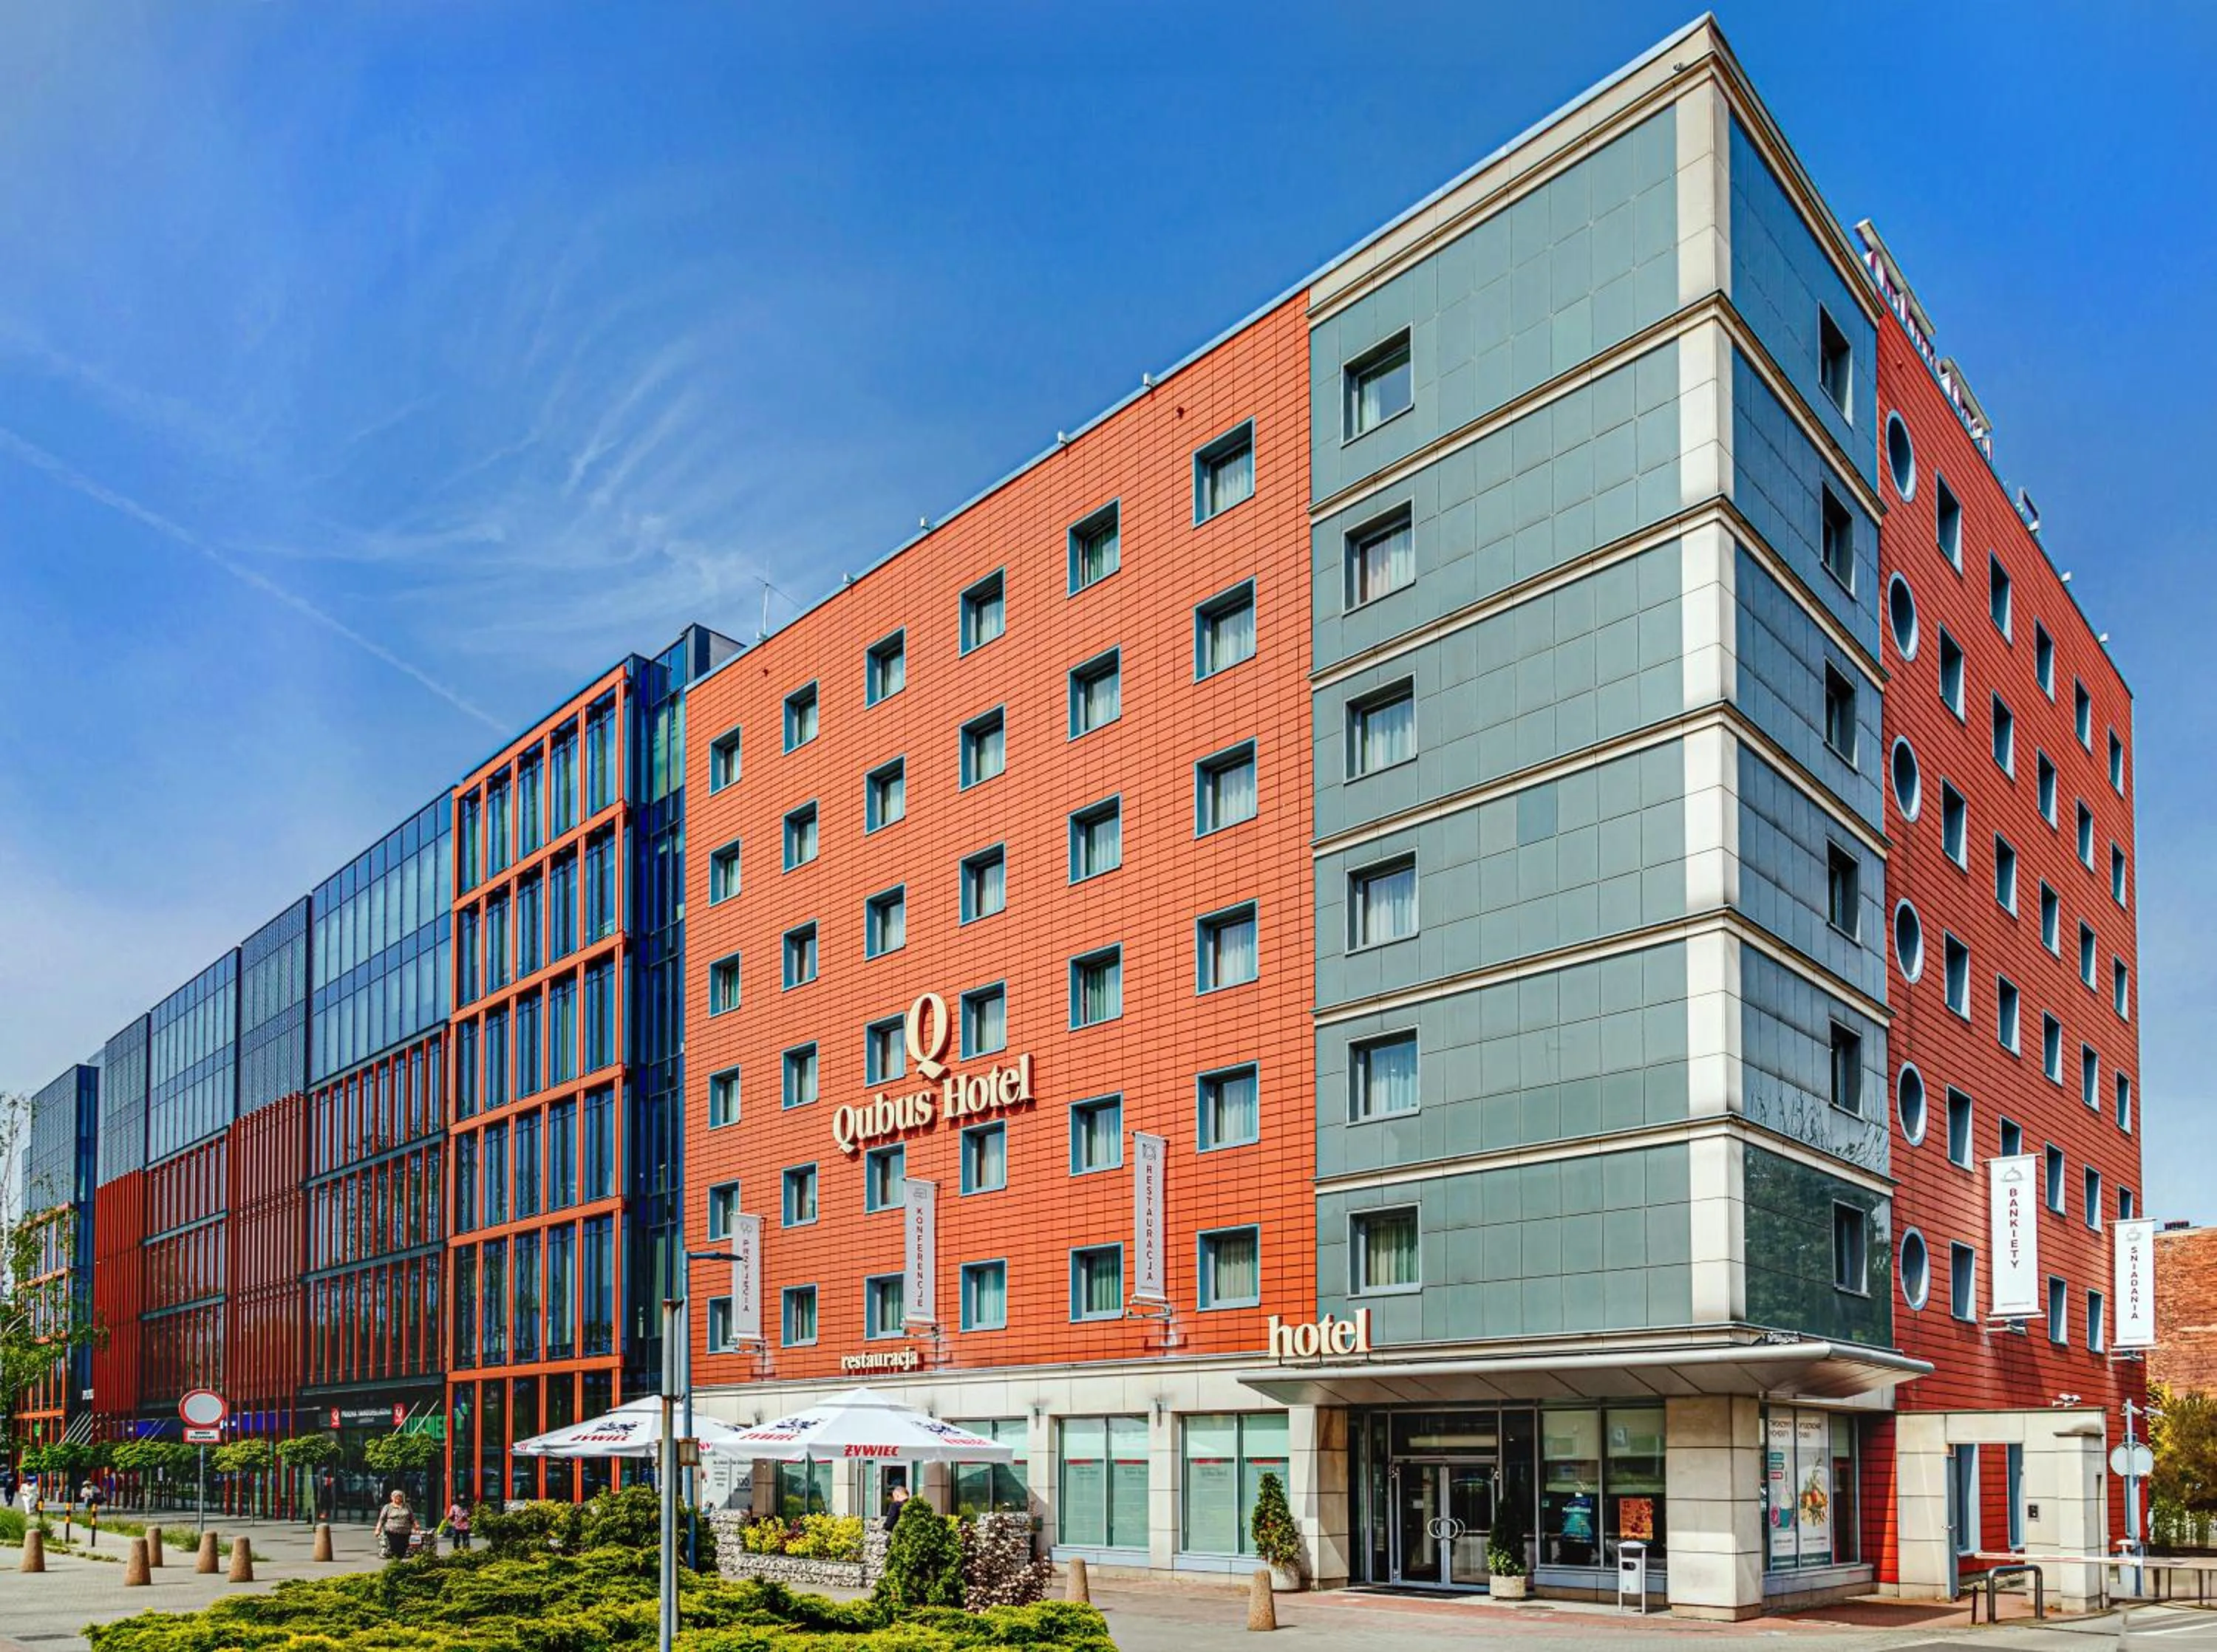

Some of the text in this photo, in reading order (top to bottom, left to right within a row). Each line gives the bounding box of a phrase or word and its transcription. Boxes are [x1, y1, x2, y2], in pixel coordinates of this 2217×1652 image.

[906, 992, 947, 1079] Q
[833, 1053, 1034, 1154] Qubus Hotel
[2009, 1187, 2019, 1269] BANKIETY
[841, 1345, 918, 1371] restauracja
[1267, 1307, 1372, 1358] hotel
